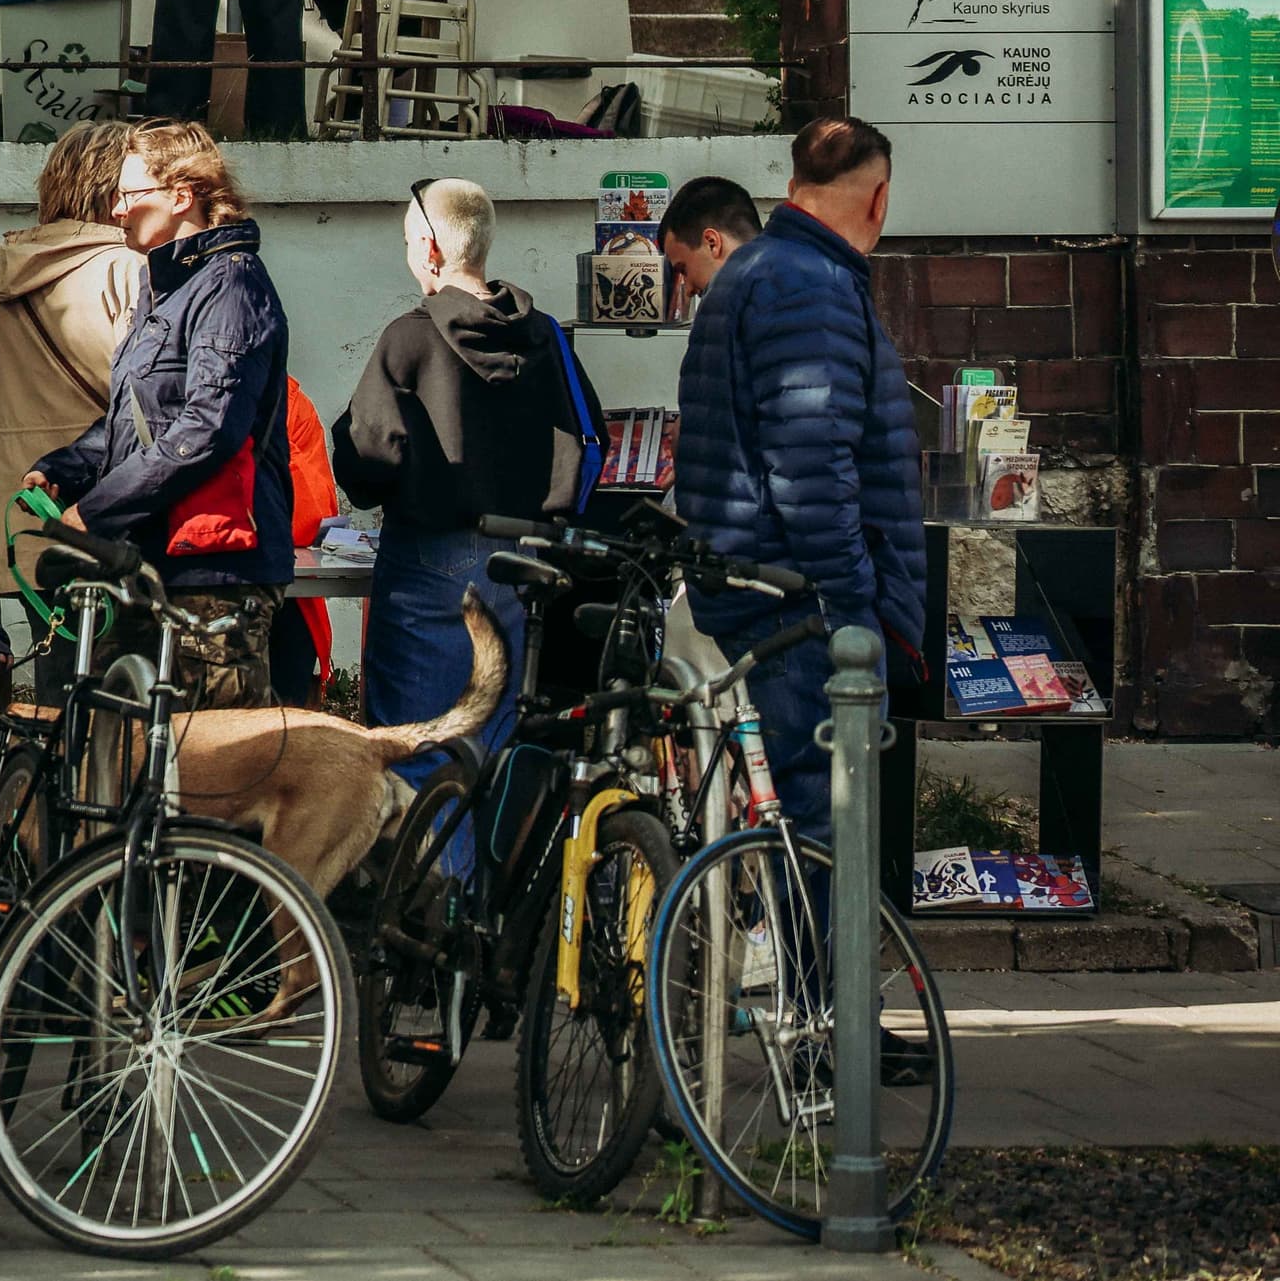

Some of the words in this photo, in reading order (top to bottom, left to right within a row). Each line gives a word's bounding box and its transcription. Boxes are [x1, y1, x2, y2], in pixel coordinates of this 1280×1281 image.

[952, 1, 998, 15] Kauno
[1001, 1, 1051, 18] skyrius
[1002, 47, 1051, 59] KAUNO
[1011, 61, 1051, 73] MENO
[997, 74, 1051, 89] KŪRĖJŲ
[908, 92, 1052, 105] ASOCIACIJA
[991, 621, 1013, 632] HI!
[950, 667, 973, 678] HI!
